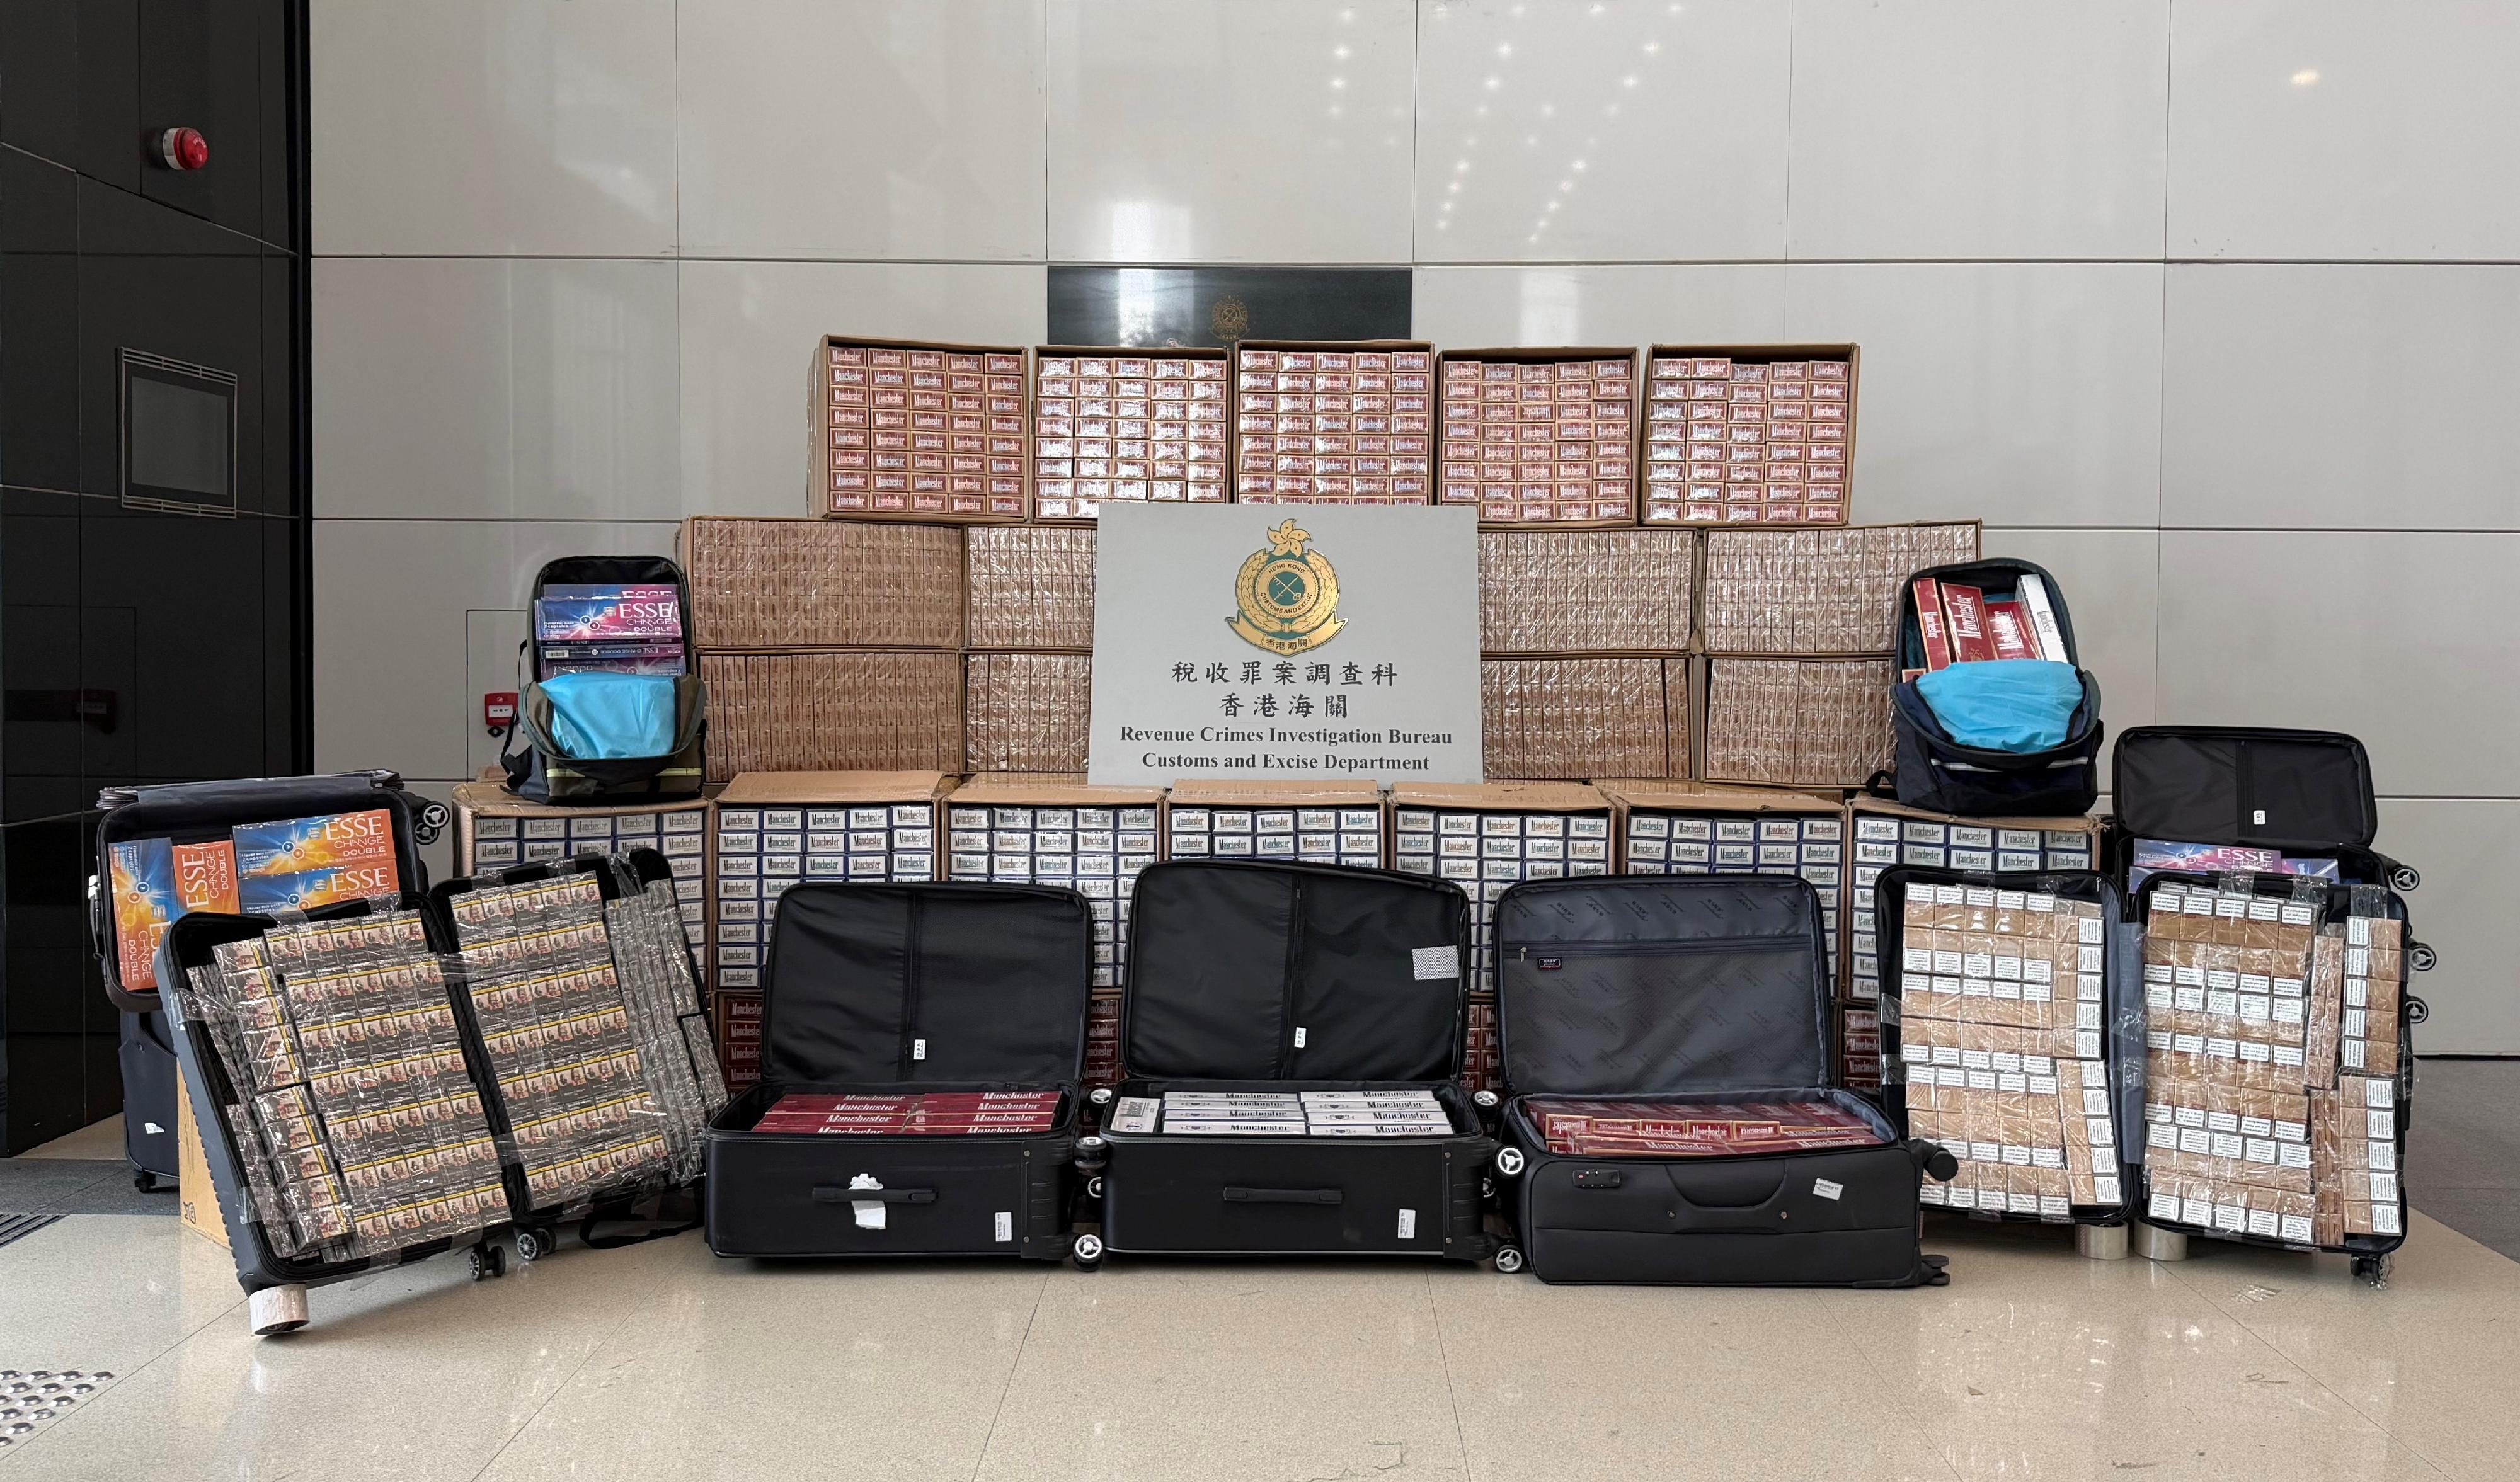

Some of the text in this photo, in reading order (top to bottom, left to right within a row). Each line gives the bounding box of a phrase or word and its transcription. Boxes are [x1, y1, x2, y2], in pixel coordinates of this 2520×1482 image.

[1697, 362, 1726, 373] Manchester
[834, 370, 863, 382] Manchester
[875, 371, 903, 382] Manchester
[914, 374, 942, 386] Manchester
[1813, 386, 1842, 397] Manchester
[834, 411, 864, 423] Manchester
[1812, 406, 1842, 418] Manchester
[876, 414, 905, 425] Manchester
[953, 416, 981, 429] Manchester
[876, 434, 905, 445] Manchester
[916, 436, 943, 447] Manchester
[954, 437, 982, 448] Manchester
[1811, 445, 1841, 457] Manchester
[1811, 467, 1840, 479] Manchester
[836, 494, 864, 507] Manchester
[953, 498, 981, 510] Manchester
[1809, 508, 1838, 520] Manchester
[1269, 564, 1305, 574] HONG KONG
[1261, 593, 1283, 613] CUSTOMS
[1297, 593, 1313, 610] EXCISE
[619, 603, 672, 618] ESSE
[1952, 595, 1982, 639] Manchester
[1922, 611, 1941, 638] Manchester
[1990, 610, 2024, 650] Manchester
[1266, 639, 1307, 651] 香港海關
[1171, 661, 1397, 687] 稅收罪案調查科
[1219, 693, 1348, 718] 香港海關
[1120, 727, 1452, 748] Revenue Crimes Investigation Bureau
[1142, 752, 1429, 773] Customs and Excise Department
[622, 818, 653, 828] Manchester
[669, 816, 698, 827] Manchester
[726, 814, 753, 826] Manchester
[768, 813, 796, 824] Manchester
[812, 813, 840, 824] Manchester
[1176, 815, 1203, 826] Manchester
[1220, 816, 1247, 826] Manchester
[1261, 818, 1288, 828] Manchester
[1346, 813, 1373, 824] Manchester
[1445, 818, 1472, 829] Manchester
[324, 816, 384, 840] ESSE
[479, 822, 511, 833] Manchester
[530, 821, 561, 833] Manchester
[577, 821, 607, 832] Manchester
[1532, 820, 1559, 831] Manchester
[1575, 821, 1603, 832] Manchester
[1636, 819, 1664, 831] Manchester
[1679, 823, 1706, 834] Manchester
[1722, 824, 1750, 836] Manchester
[1766, 824, 1794, 835] Manchester
[1809, 823, 1837, 834] Manchester
[1910, 825, 1940, 837] Manchester
[1956, 829, 1986, 841] Manchester
[335, 836, 384, 848] CHANGE
[669, 838, 698, 849] Manchester
[724, 835, 752, 846] Manchester
[811, 836, 839, 847] Manchester
[854, 835, 883, 845] Manchester
[1176, 837, 1203, 848] Manchester
[1219, 839, 1246, 850] Manchester
[1346, 836, 1373, 847] Manchester
[1401, 837, 1429, 848] Manchester
[2005, 833, 2034, 845] Manchester
[481, 845, 513, 855] Manchester
[529, 845, 559, 857] Manchester
[1445, 840, 1472, 851] Manchester
[1572, 843, 1600, 854] Manchester
[1633, 843, 1661, 853] Manchester
[1862, 845, 1893, 857] Manchester
[343, 846, 386, 857] DOUBLE
[1721, 848, 1748, 859] Manchester
[1807, 847, 1834, 857] Manchester
[1910, 848, 1940, 860] Manchester
[2218, 848, 2273, 863] ESSE
[811, 859, 839, 870] Manchester
[1956, 853, 1986, 865] Manchester
[2003, 855, 2034, 867] Manchester
[2053, 855, 2083, 867] Manchester
[218, 850, 229, 889] DOUBLE
[1445, 862, 1472, 874] Manchester
[1531, 865, 1557, 876] Manchester
[182, 852, 209, 908] ESSE
[206, 851, 219, 898] CHANGE
[330, 867, 389, 892] ESSE
[724, 882, 752, 893] Manchester
[726, 904, 754, 915] Manchester
[129, 940, 139, 981] DOUBLE
[723, 950, 751, 960] Manchester
[725, 971, 753, 982] Manchester
[1797, 1138, 1865, 1148] Manchester
